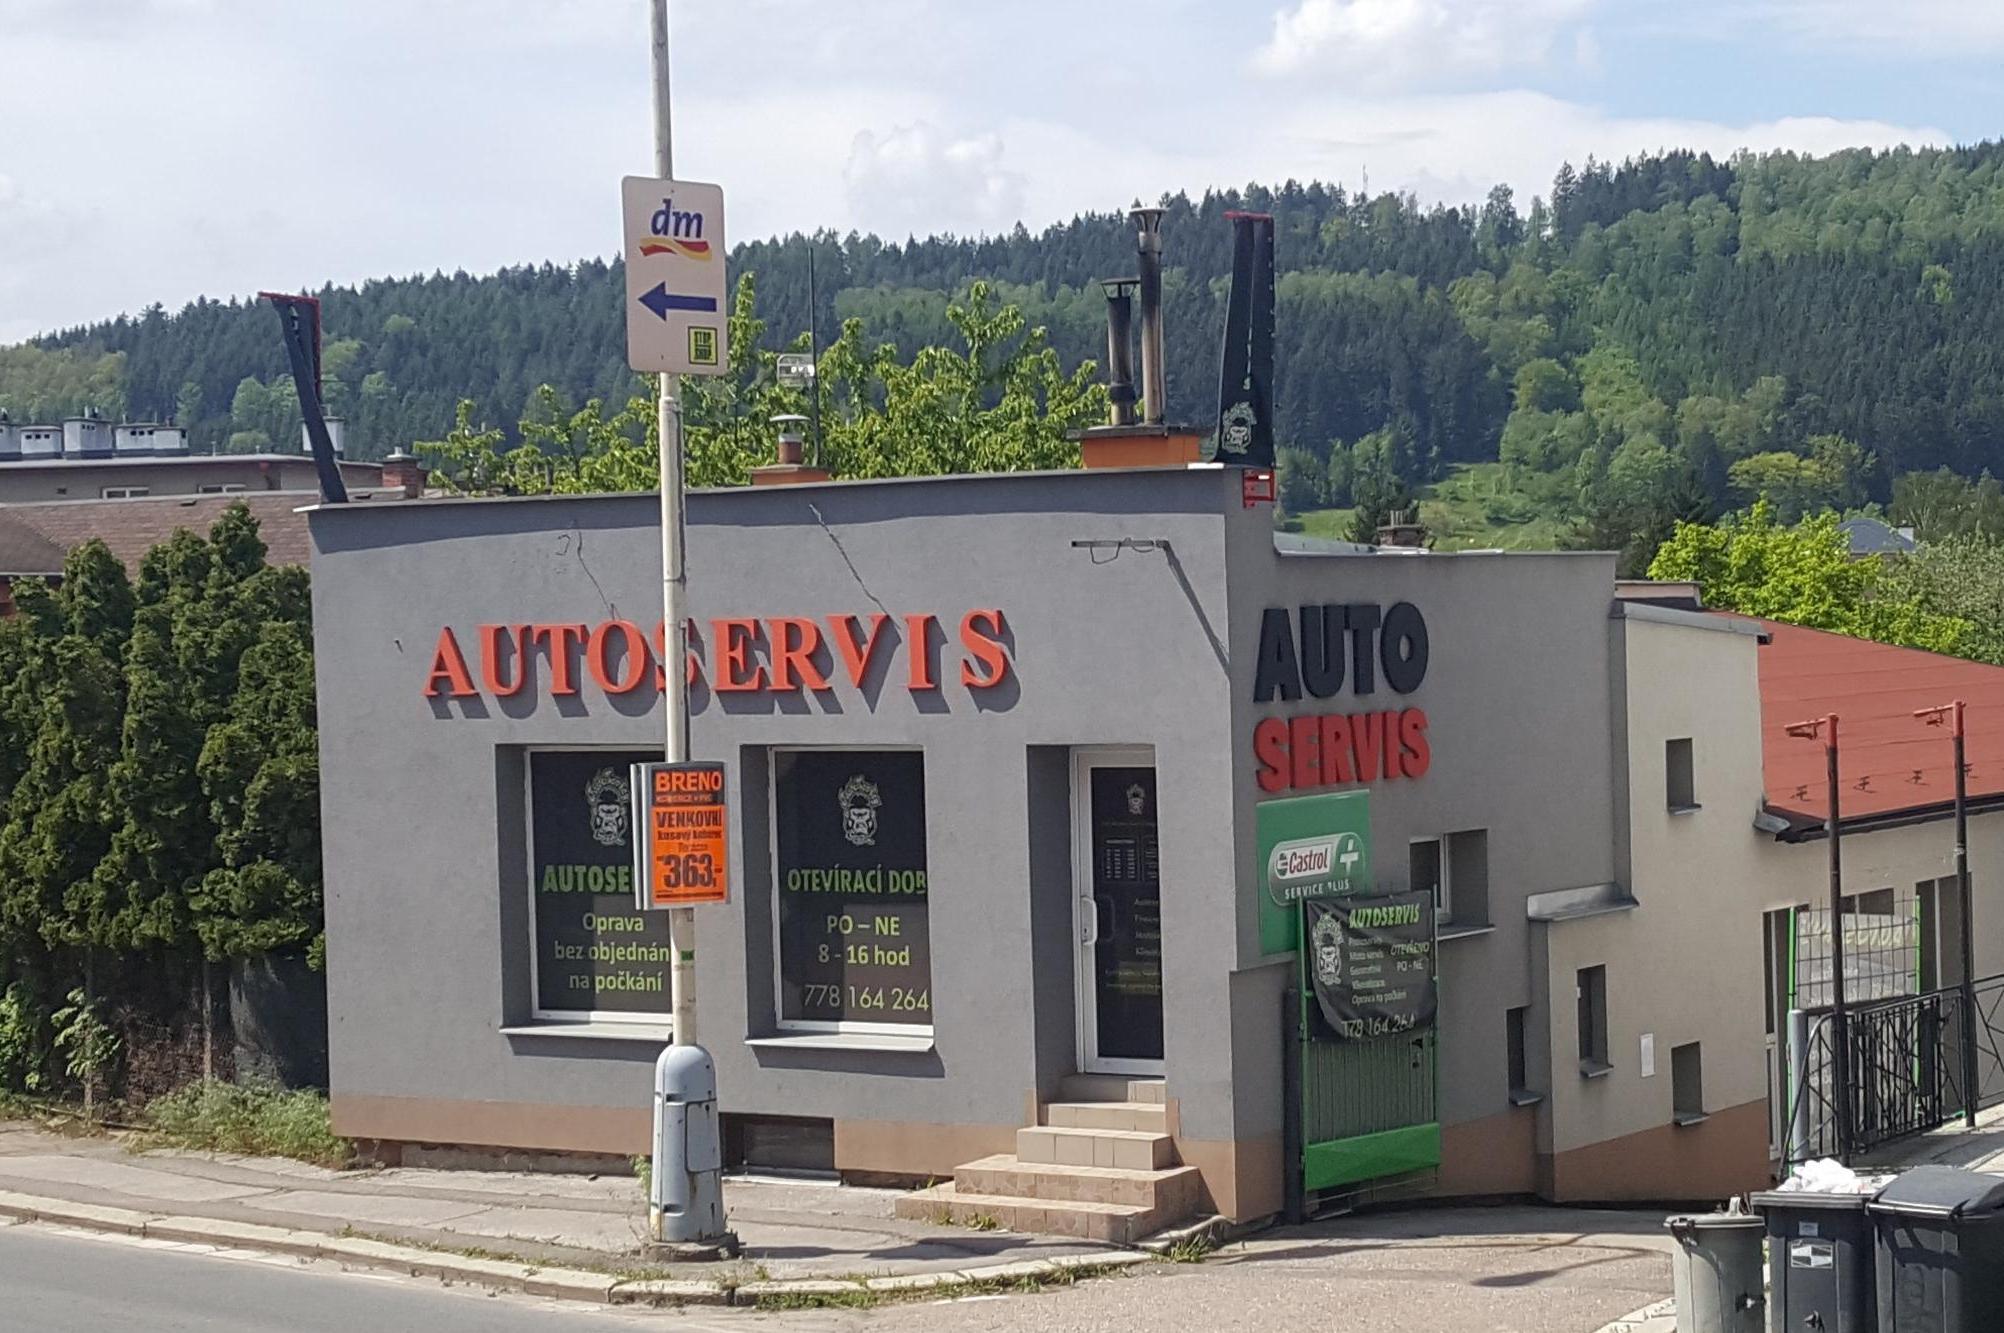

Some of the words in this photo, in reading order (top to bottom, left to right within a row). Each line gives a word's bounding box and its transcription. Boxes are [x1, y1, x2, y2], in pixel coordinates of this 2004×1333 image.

[651, 199, 703, 239] dm
[1253, 602, 1429, 702] AUTO
[1253, 707, 1430, 793] SERVIS
[656, 770, 722, 793] BRENO
[1289, 847, 1329, 875] Castrol
[543, 864, 635, 893] AUTOSE
[788, 863, 882, 894] OTEVÍRACÍ
[1284, 882, 1325, 900] SERVICE
[582, 912, 645, 936] Oprava
[827, 915, 853, 935] PO
[875, 916, 900, 936] NE
[1348, 902, 1420, 929] AUTOSERVIS
[554, 940, 584, 961] bez
[818, 943, 829, 963] 8
[847, 944, 869, 965] 16
[874, 944, 911, 966] hod
[569, 975, 589, 990] na
[595, 971, 664, 994] počkání
[804, 984, 840, 1008] 778
[848, 985, 886, 1010] 164
[891, 987, 930, 1012] 264
